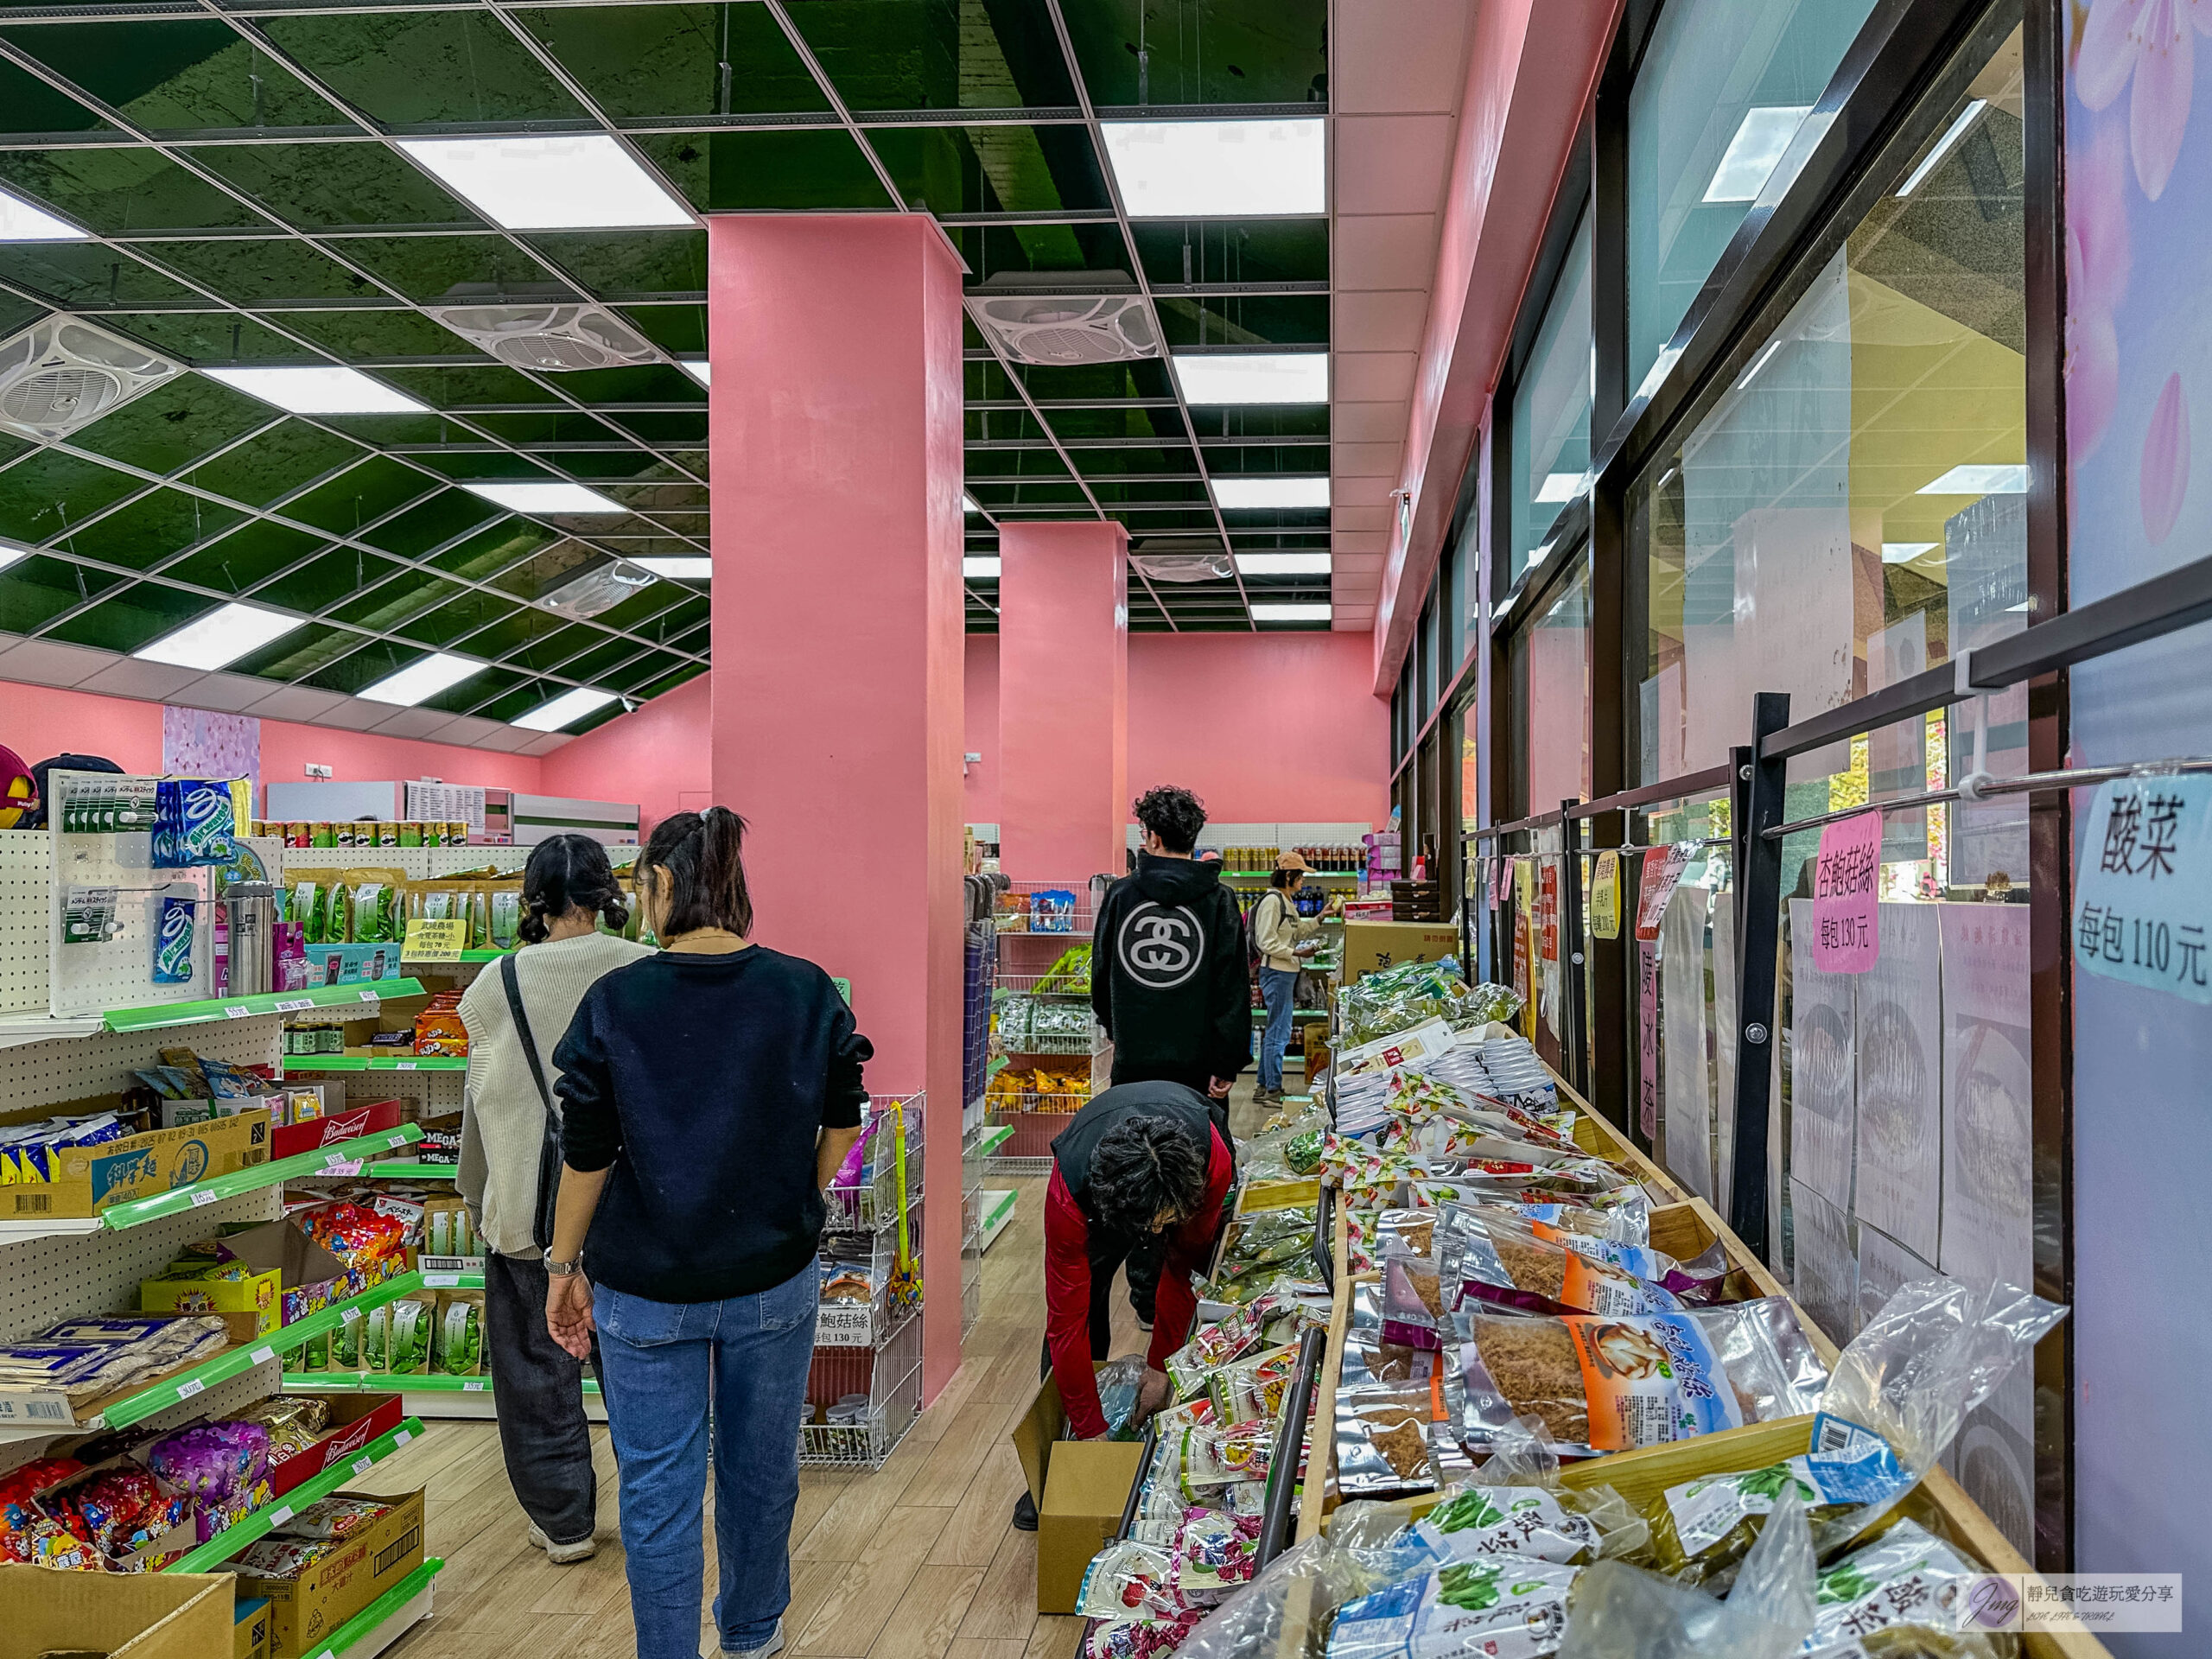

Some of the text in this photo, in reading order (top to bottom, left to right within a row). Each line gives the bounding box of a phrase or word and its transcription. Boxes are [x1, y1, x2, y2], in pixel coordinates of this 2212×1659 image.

[2101, 794, 2185, 880] 酸菜
[1819, 842, 1874, 899] 杏鮑菇絲
[421, 921, 454, 930] 武陵農場
[1821, 915, 1868, 950] 每包 130 元
[2078, 902, 2207, 986] 每包 110 元
[324, 1122, 365, 1141] Budweiser
[426, 1133, 456, 1145] MEGA
[427, 1154, 450, 1163] MEGA
[194, 1192, 214, 1204] 16元
[387, 1206, 413, 1216] ベビースター
[834, 1333, 849, 1342] 130
[851, 1333, 862, 1343] 元
[326, 1433, 365, 1462] Budweiser
